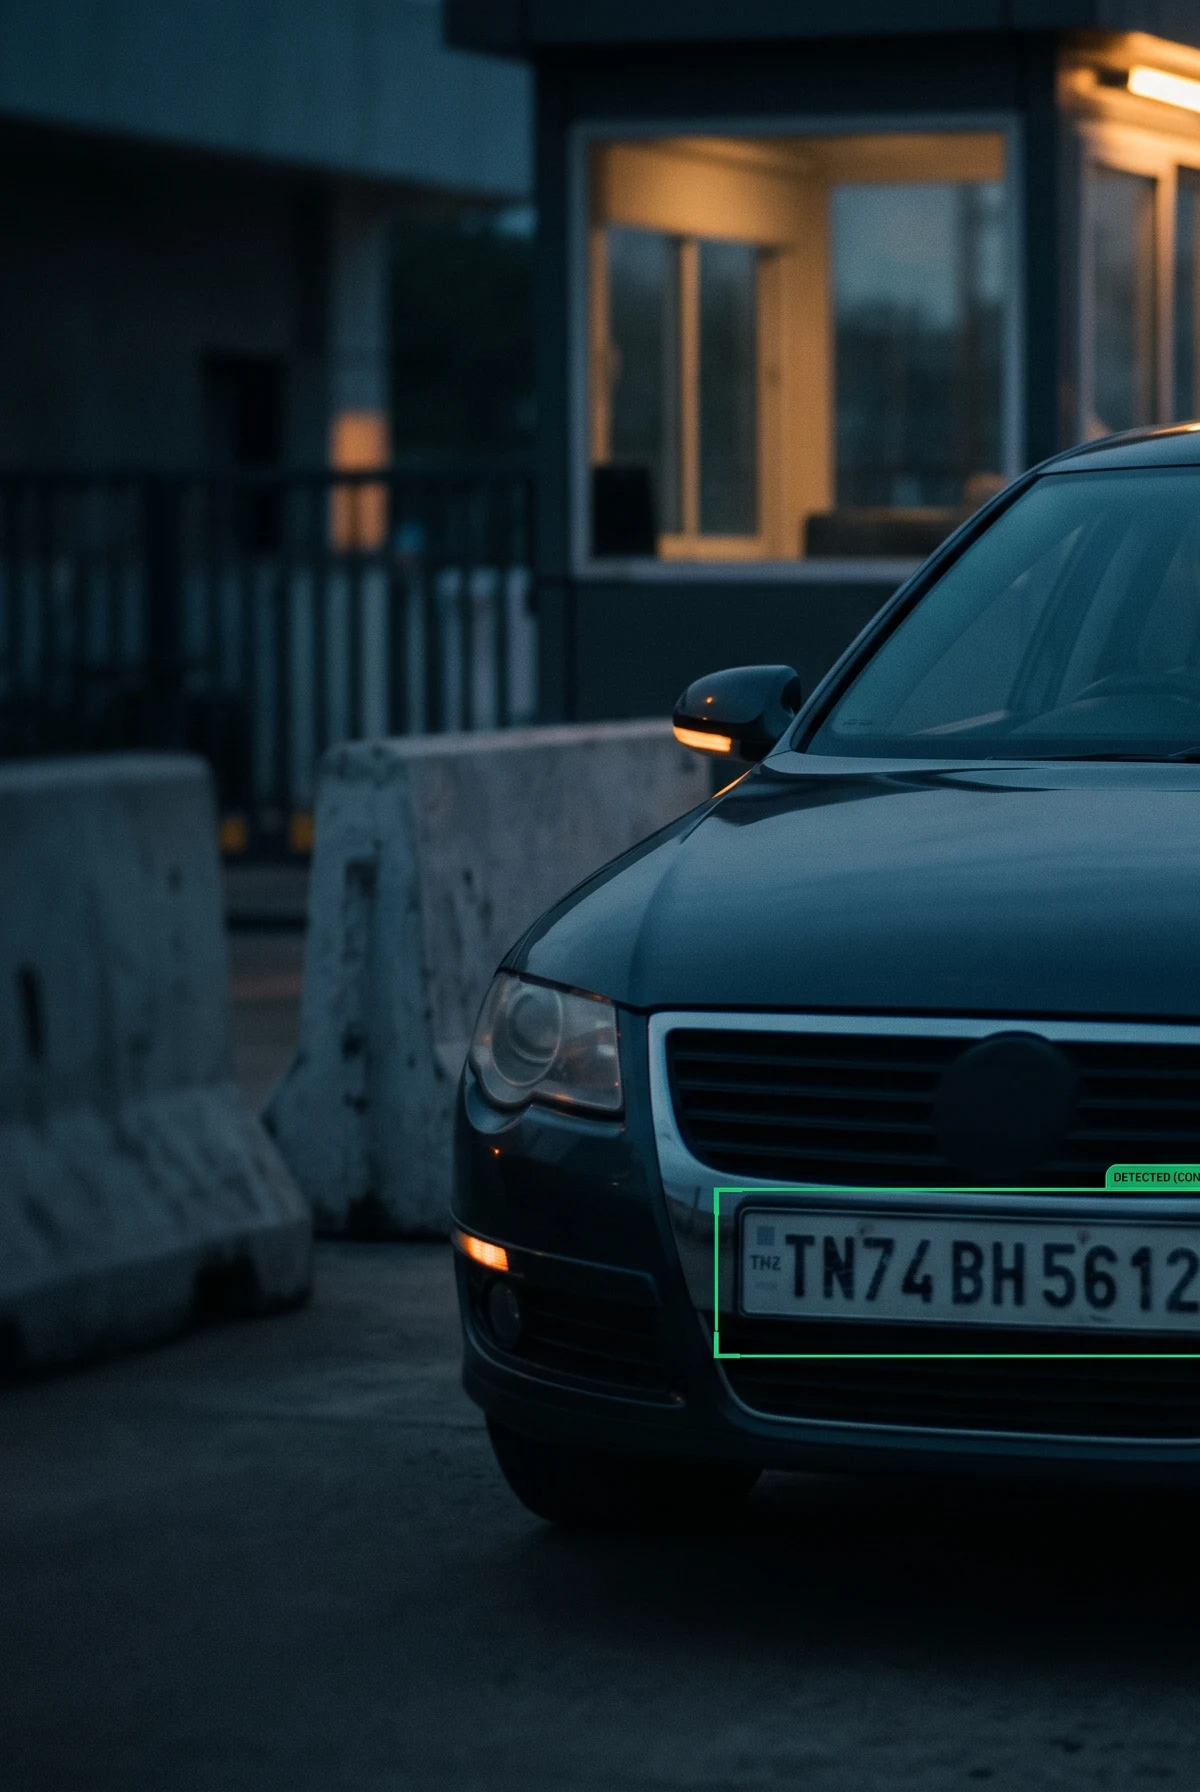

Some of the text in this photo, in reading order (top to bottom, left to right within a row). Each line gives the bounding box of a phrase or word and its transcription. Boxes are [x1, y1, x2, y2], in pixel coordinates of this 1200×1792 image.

[785, 1234, 1200, 1314] TN74 BH 5612
